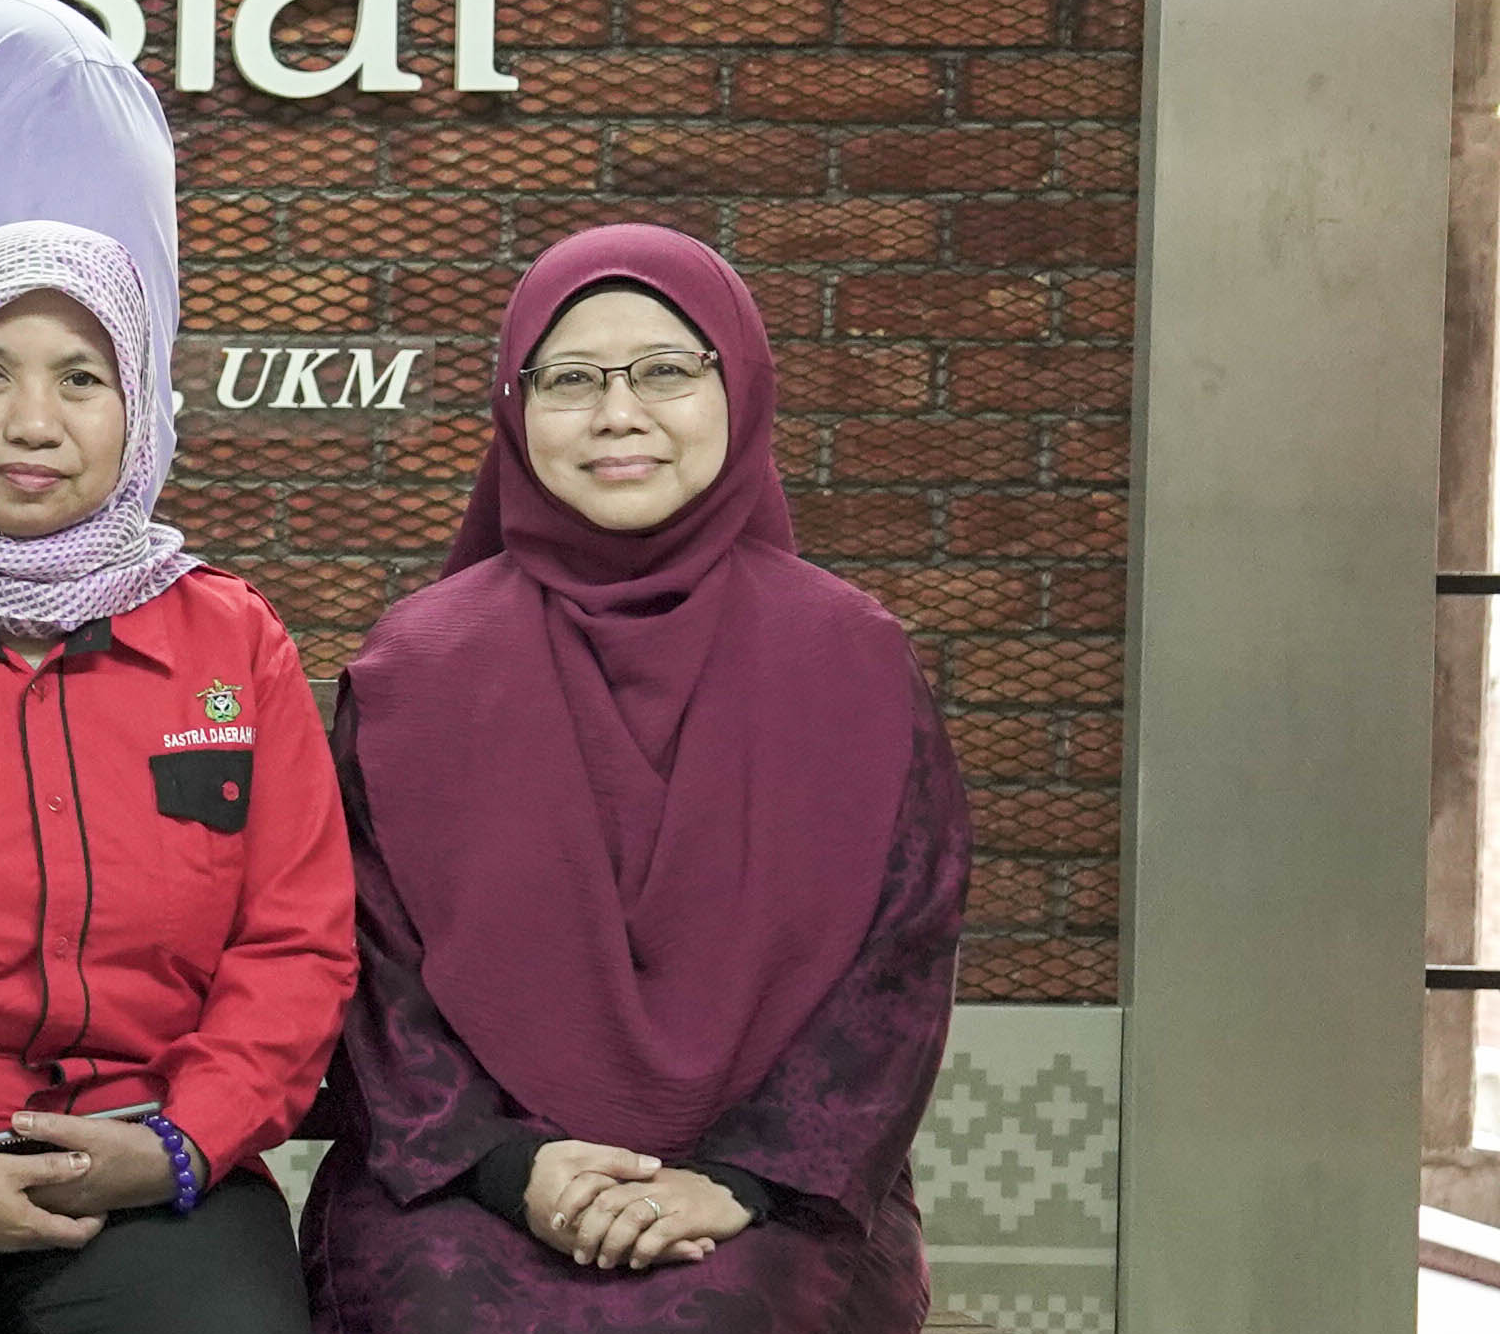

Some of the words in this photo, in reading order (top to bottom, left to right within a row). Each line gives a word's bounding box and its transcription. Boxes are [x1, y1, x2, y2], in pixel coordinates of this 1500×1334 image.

[217, 347, 423, 409] UKM
[163, 728, 208, 748] SASTRA
[209, 726, 252, 744] DAERAH
